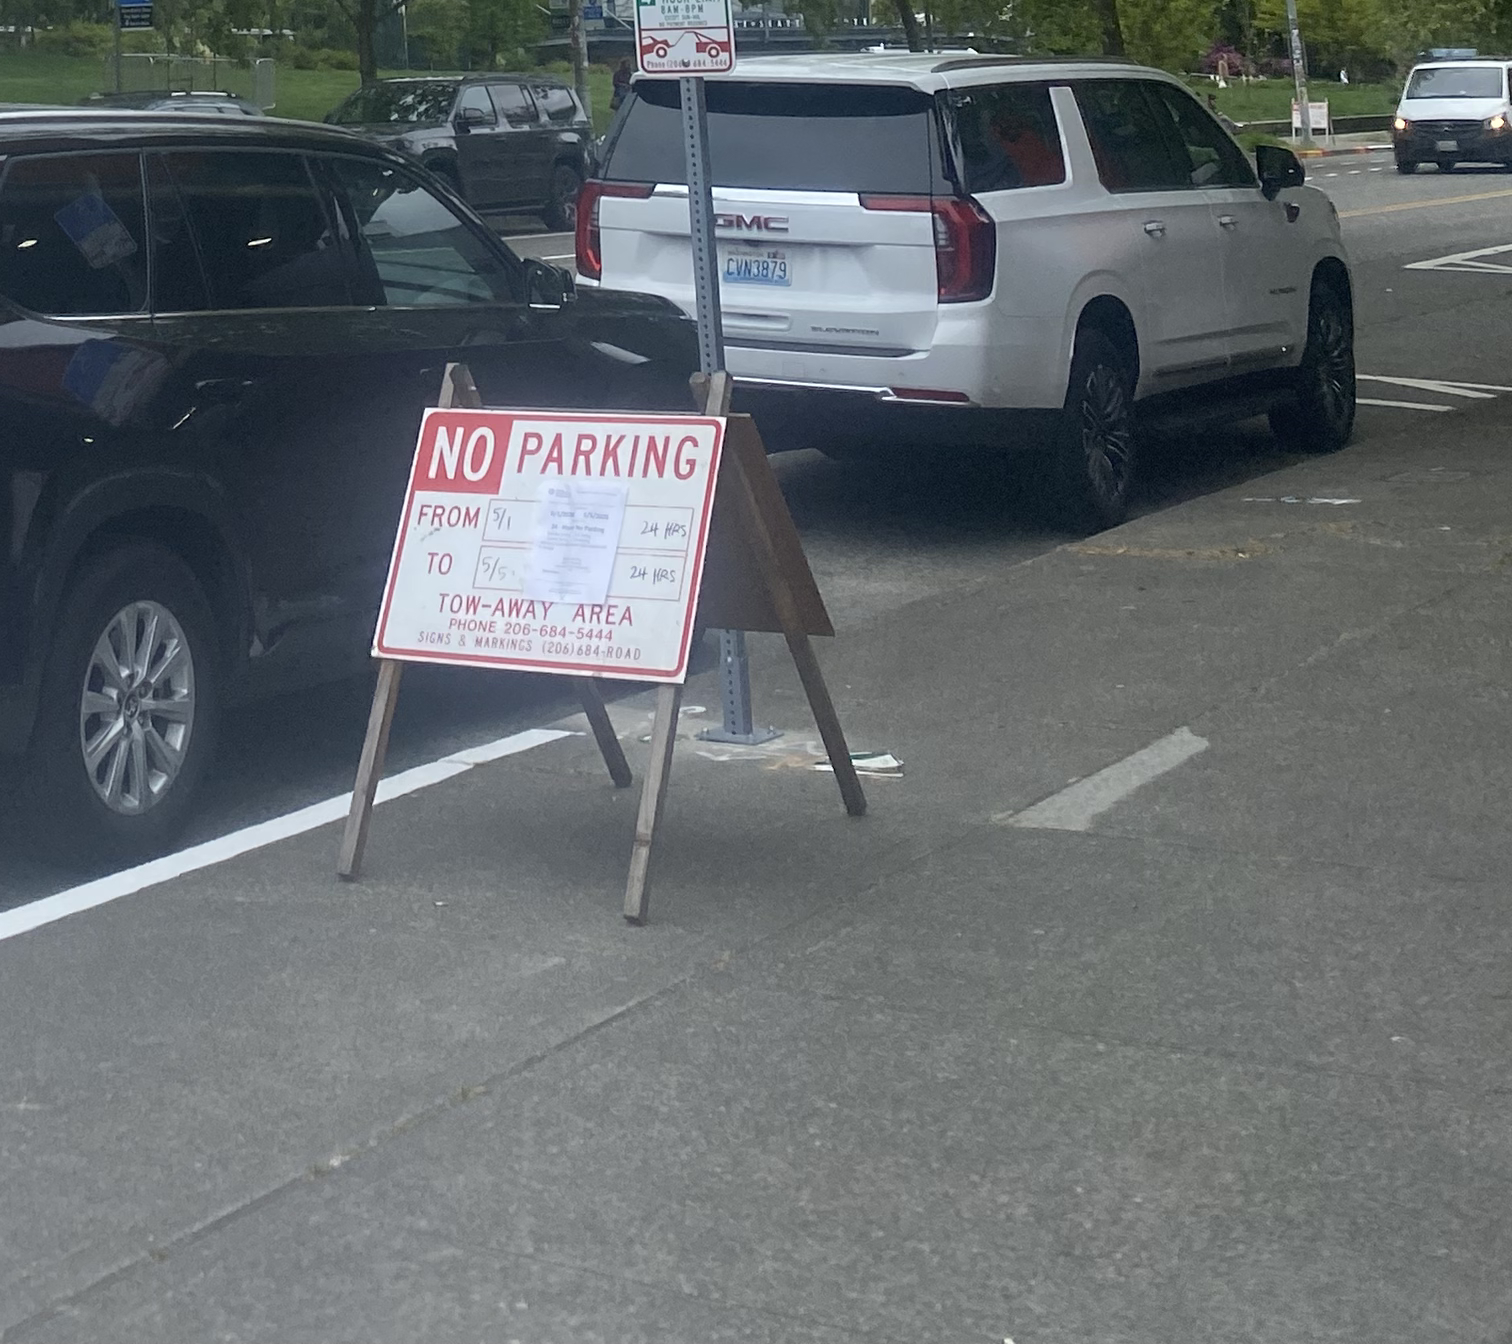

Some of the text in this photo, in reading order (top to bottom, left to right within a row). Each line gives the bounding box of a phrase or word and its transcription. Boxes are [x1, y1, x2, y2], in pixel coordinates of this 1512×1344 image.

[714, 213, 789, 232] GMC
[726, 257, 787, 280] CVN3879
[427, 425, 699, 482] NO PARKING
[417, 504, 481, 529] FROM
[493, 506, 512, 531] 5/1
[640, 520, 688, 540] 24 HRS
[427, 552, 453, 575] TO
[629, 565, 677, 585] 24 HRS
[438, 593, 634, 627] TOW-AWAY AREA
[417, 630, 452, 645] SIGNS
[458, 634, 466, 647] &
[474, 636, 533, 653] MARKINGS
[448, 618, 614, 642] PHONE 206-684-5444
